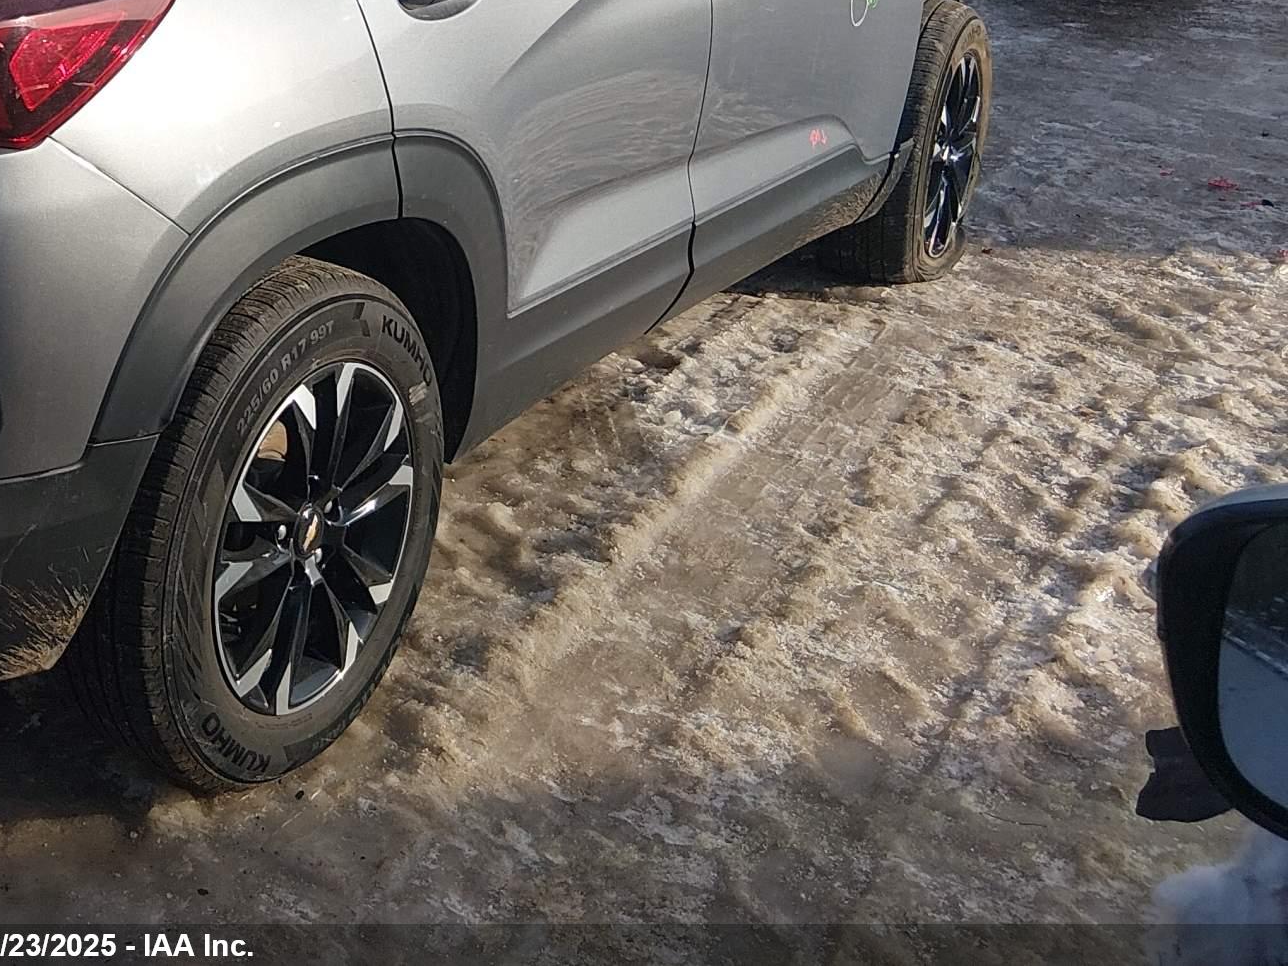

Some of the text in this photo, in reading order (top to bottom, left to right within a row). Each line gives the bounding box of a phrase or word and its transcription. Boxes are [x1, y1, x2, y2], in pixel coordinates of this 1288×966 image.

[236, 320, 335, 438] 225/60 R17 99T
[381, 313, 432, 387] KUMHO
[201, 712, 272, 773] KUMHO
